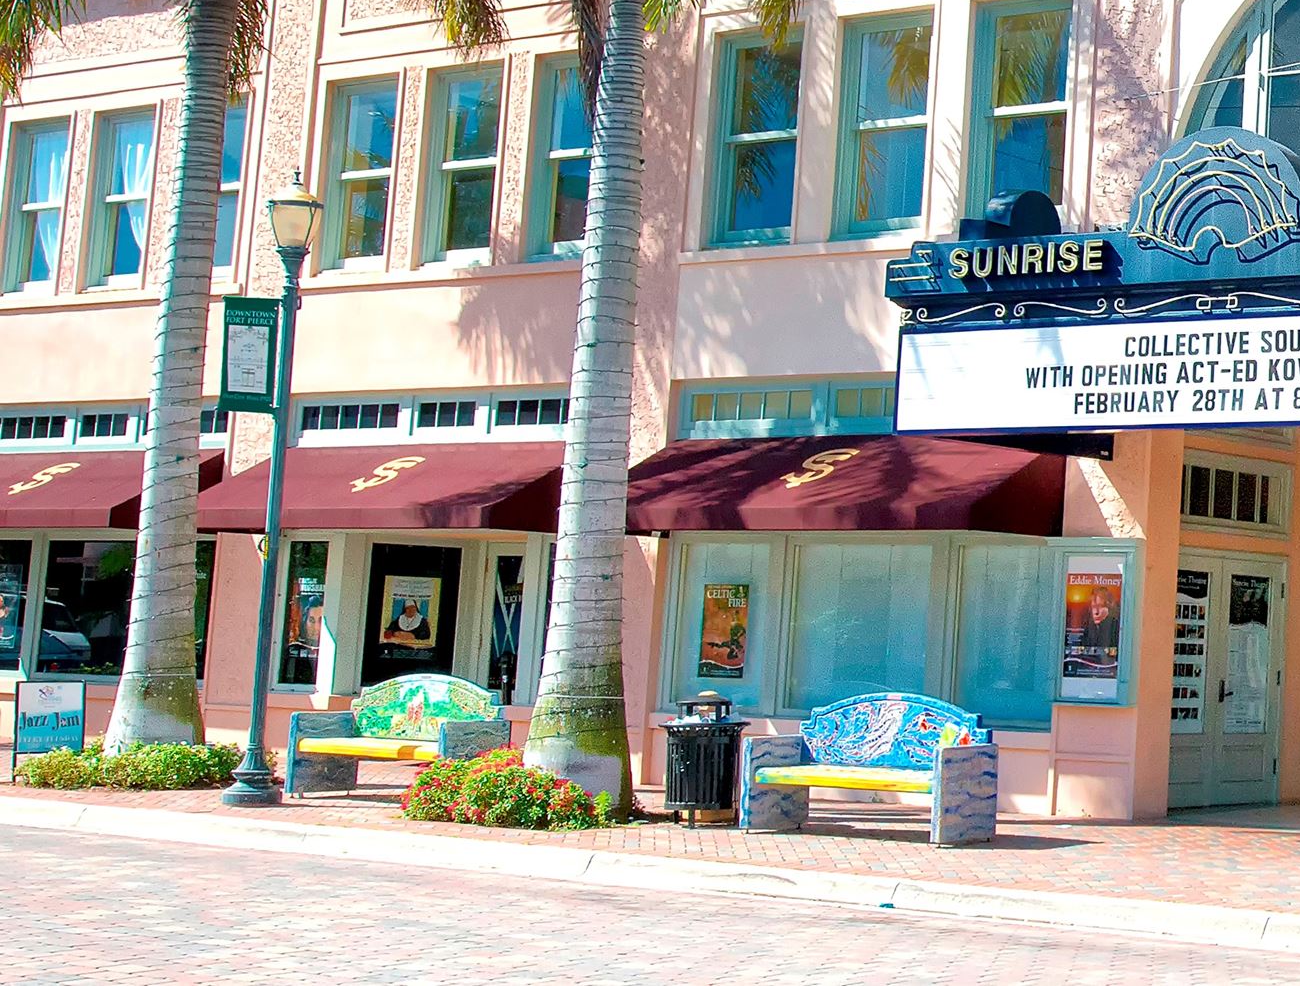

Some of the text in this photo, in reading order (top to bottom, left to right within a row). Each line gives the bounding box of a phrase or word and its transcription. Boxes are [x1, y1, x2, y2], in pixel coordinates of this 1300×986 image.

[949, 239, 1104, 279] SUNRISE
[226, 310, 276, 318] DOWNTOWN
[1125, 332, 1249, 357] COLLECTIVE
[1026, 366, 1073, 388] WITH
[1082, 363, 1167, 387] OPENING
[1176, 360, 1258, 384] ACT-ED
[1074, 390, 1179, 414] FEBRUARY
[1192, 389, 1244, 412] 28TH
[1254, 387, 1284, 410] AT
[1069, 575, 1122, 587] Eddie Money
[707, 589, 736, 599] CELTIC
[728, 598, 747, 607] FIRE
[19, 712, 80, 731] Jazz Jam
